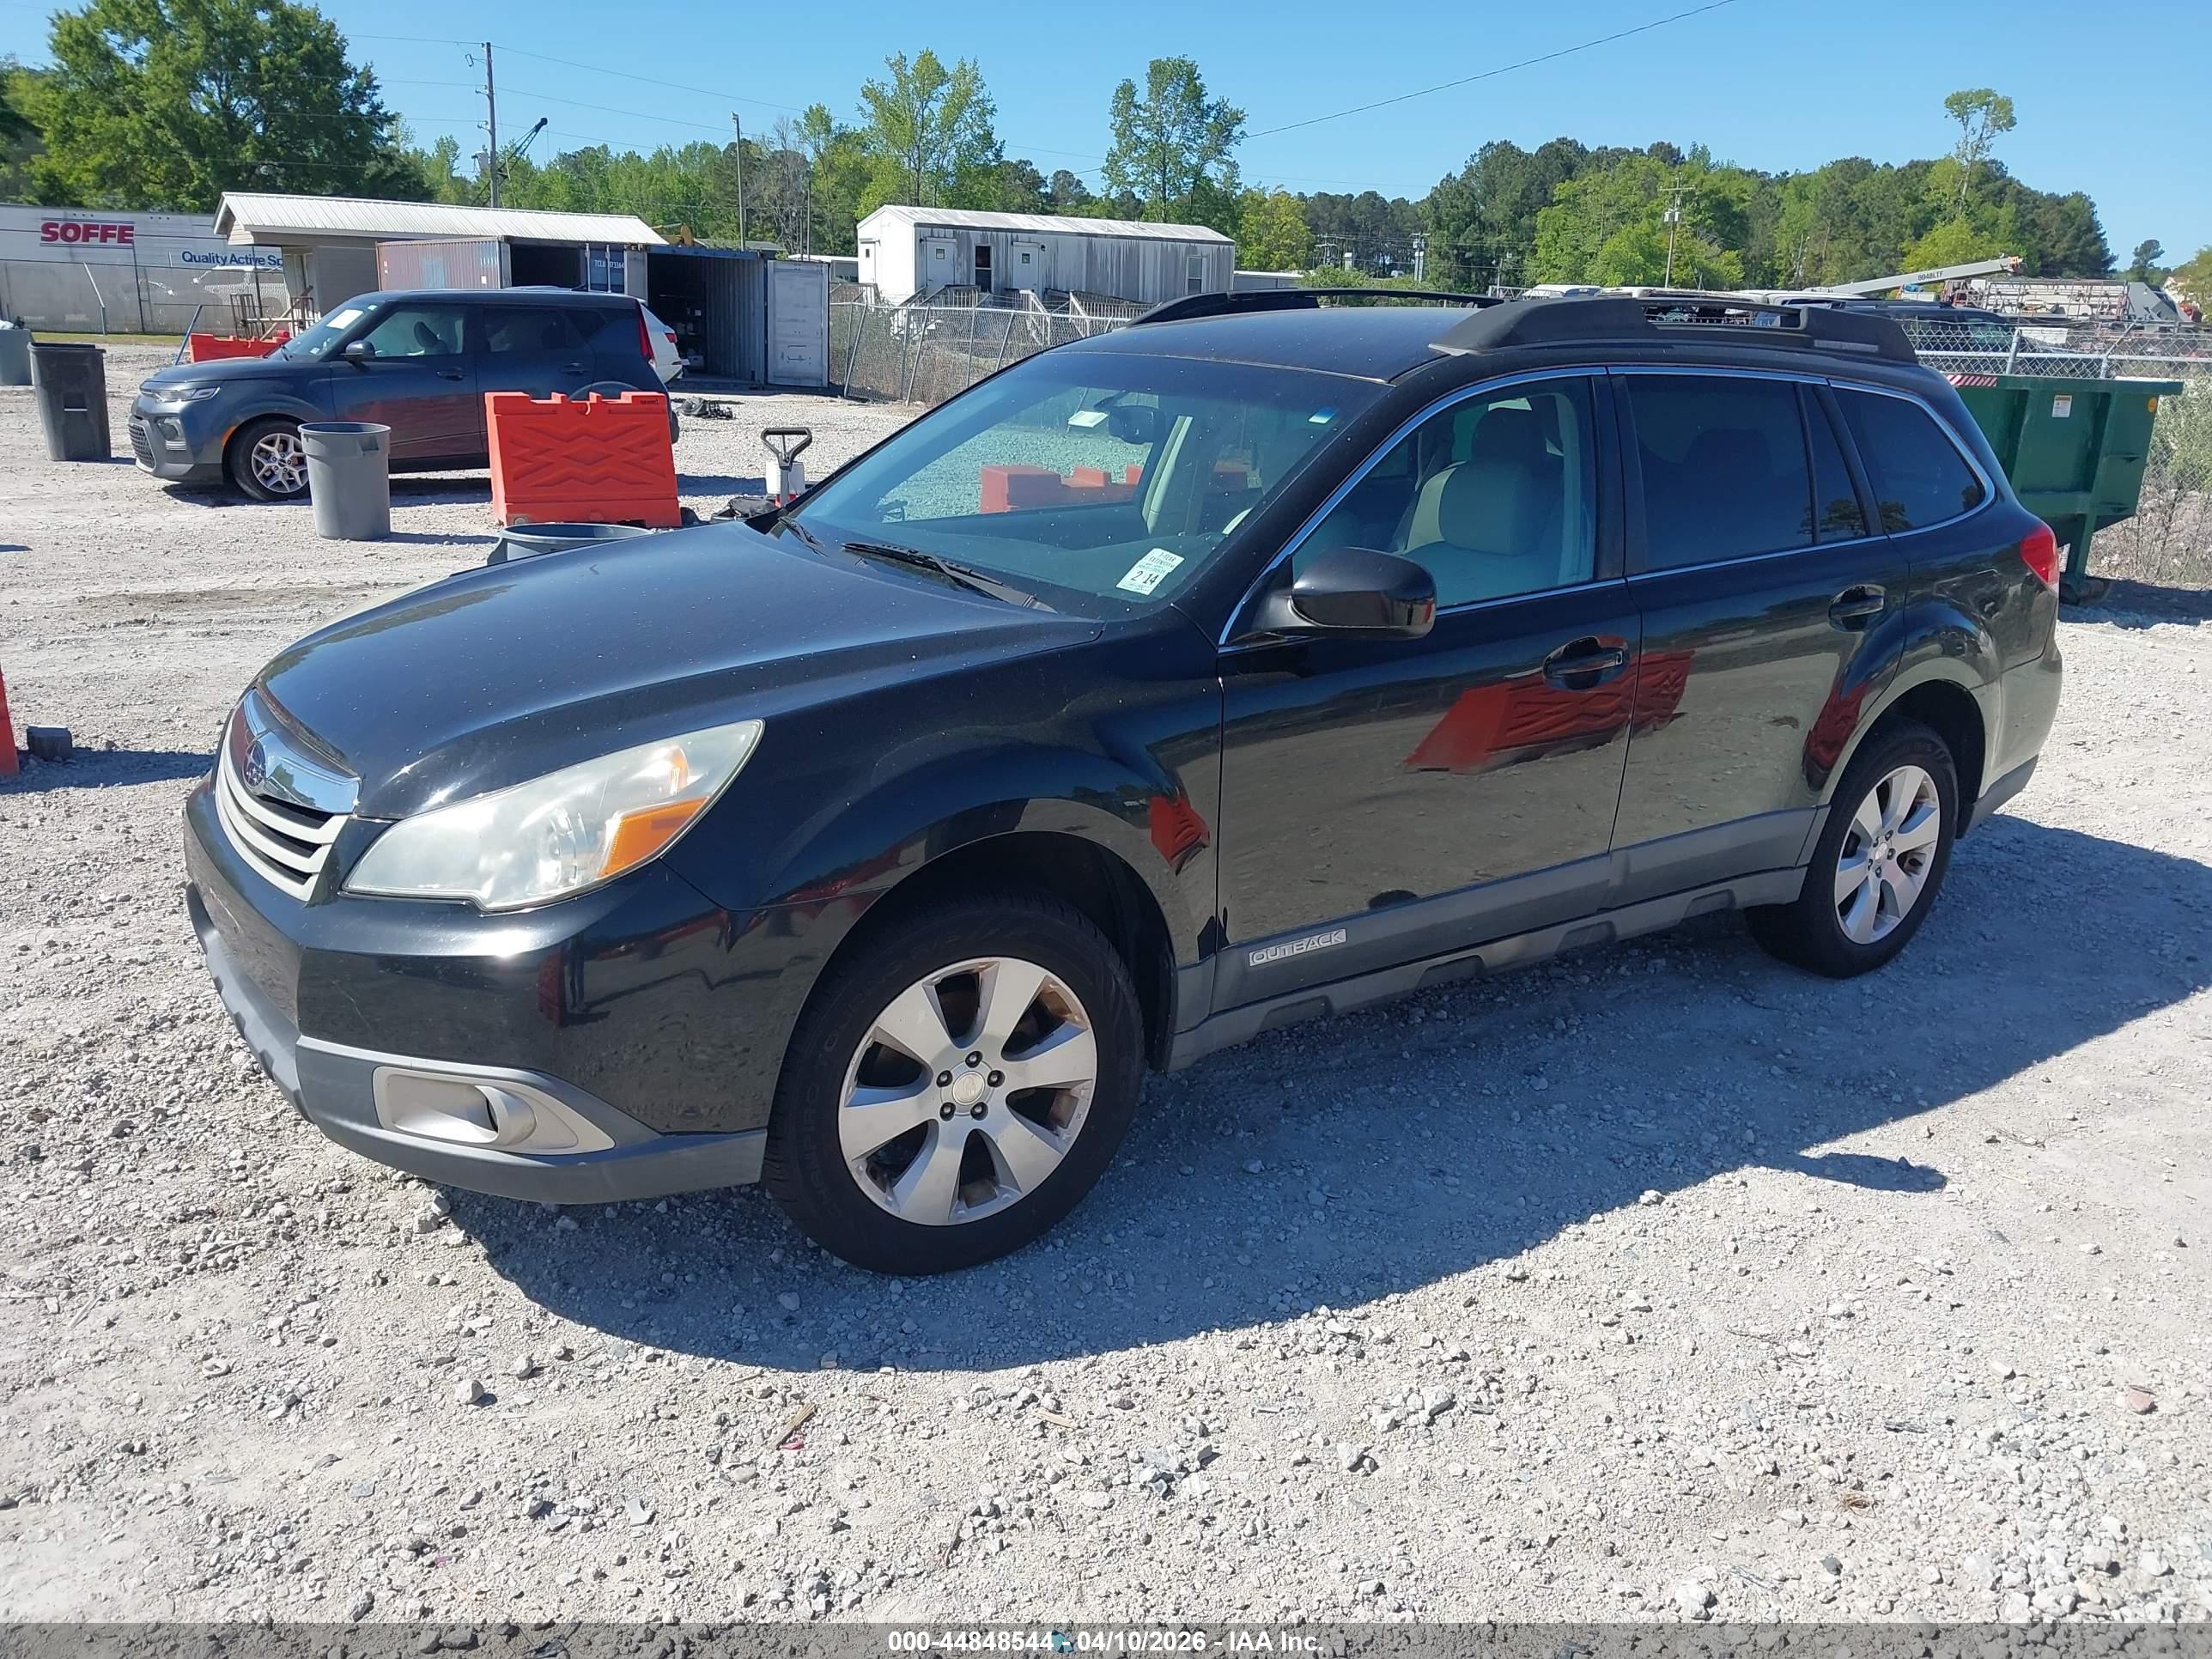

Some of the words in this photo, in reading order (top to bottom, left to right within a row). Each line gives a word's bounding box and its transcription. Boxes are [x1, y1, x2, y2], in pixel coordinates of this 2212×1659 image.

[40, 222, 135, 244] SOFFE
[181, 251, 227, 266] Quality
[229, 253, 265, 266] Active
[1130, 570, 1143, 581] 2
[1143, 573, 1159, 586] 14
[1251, 930, 1342, 963] OUTBACK
